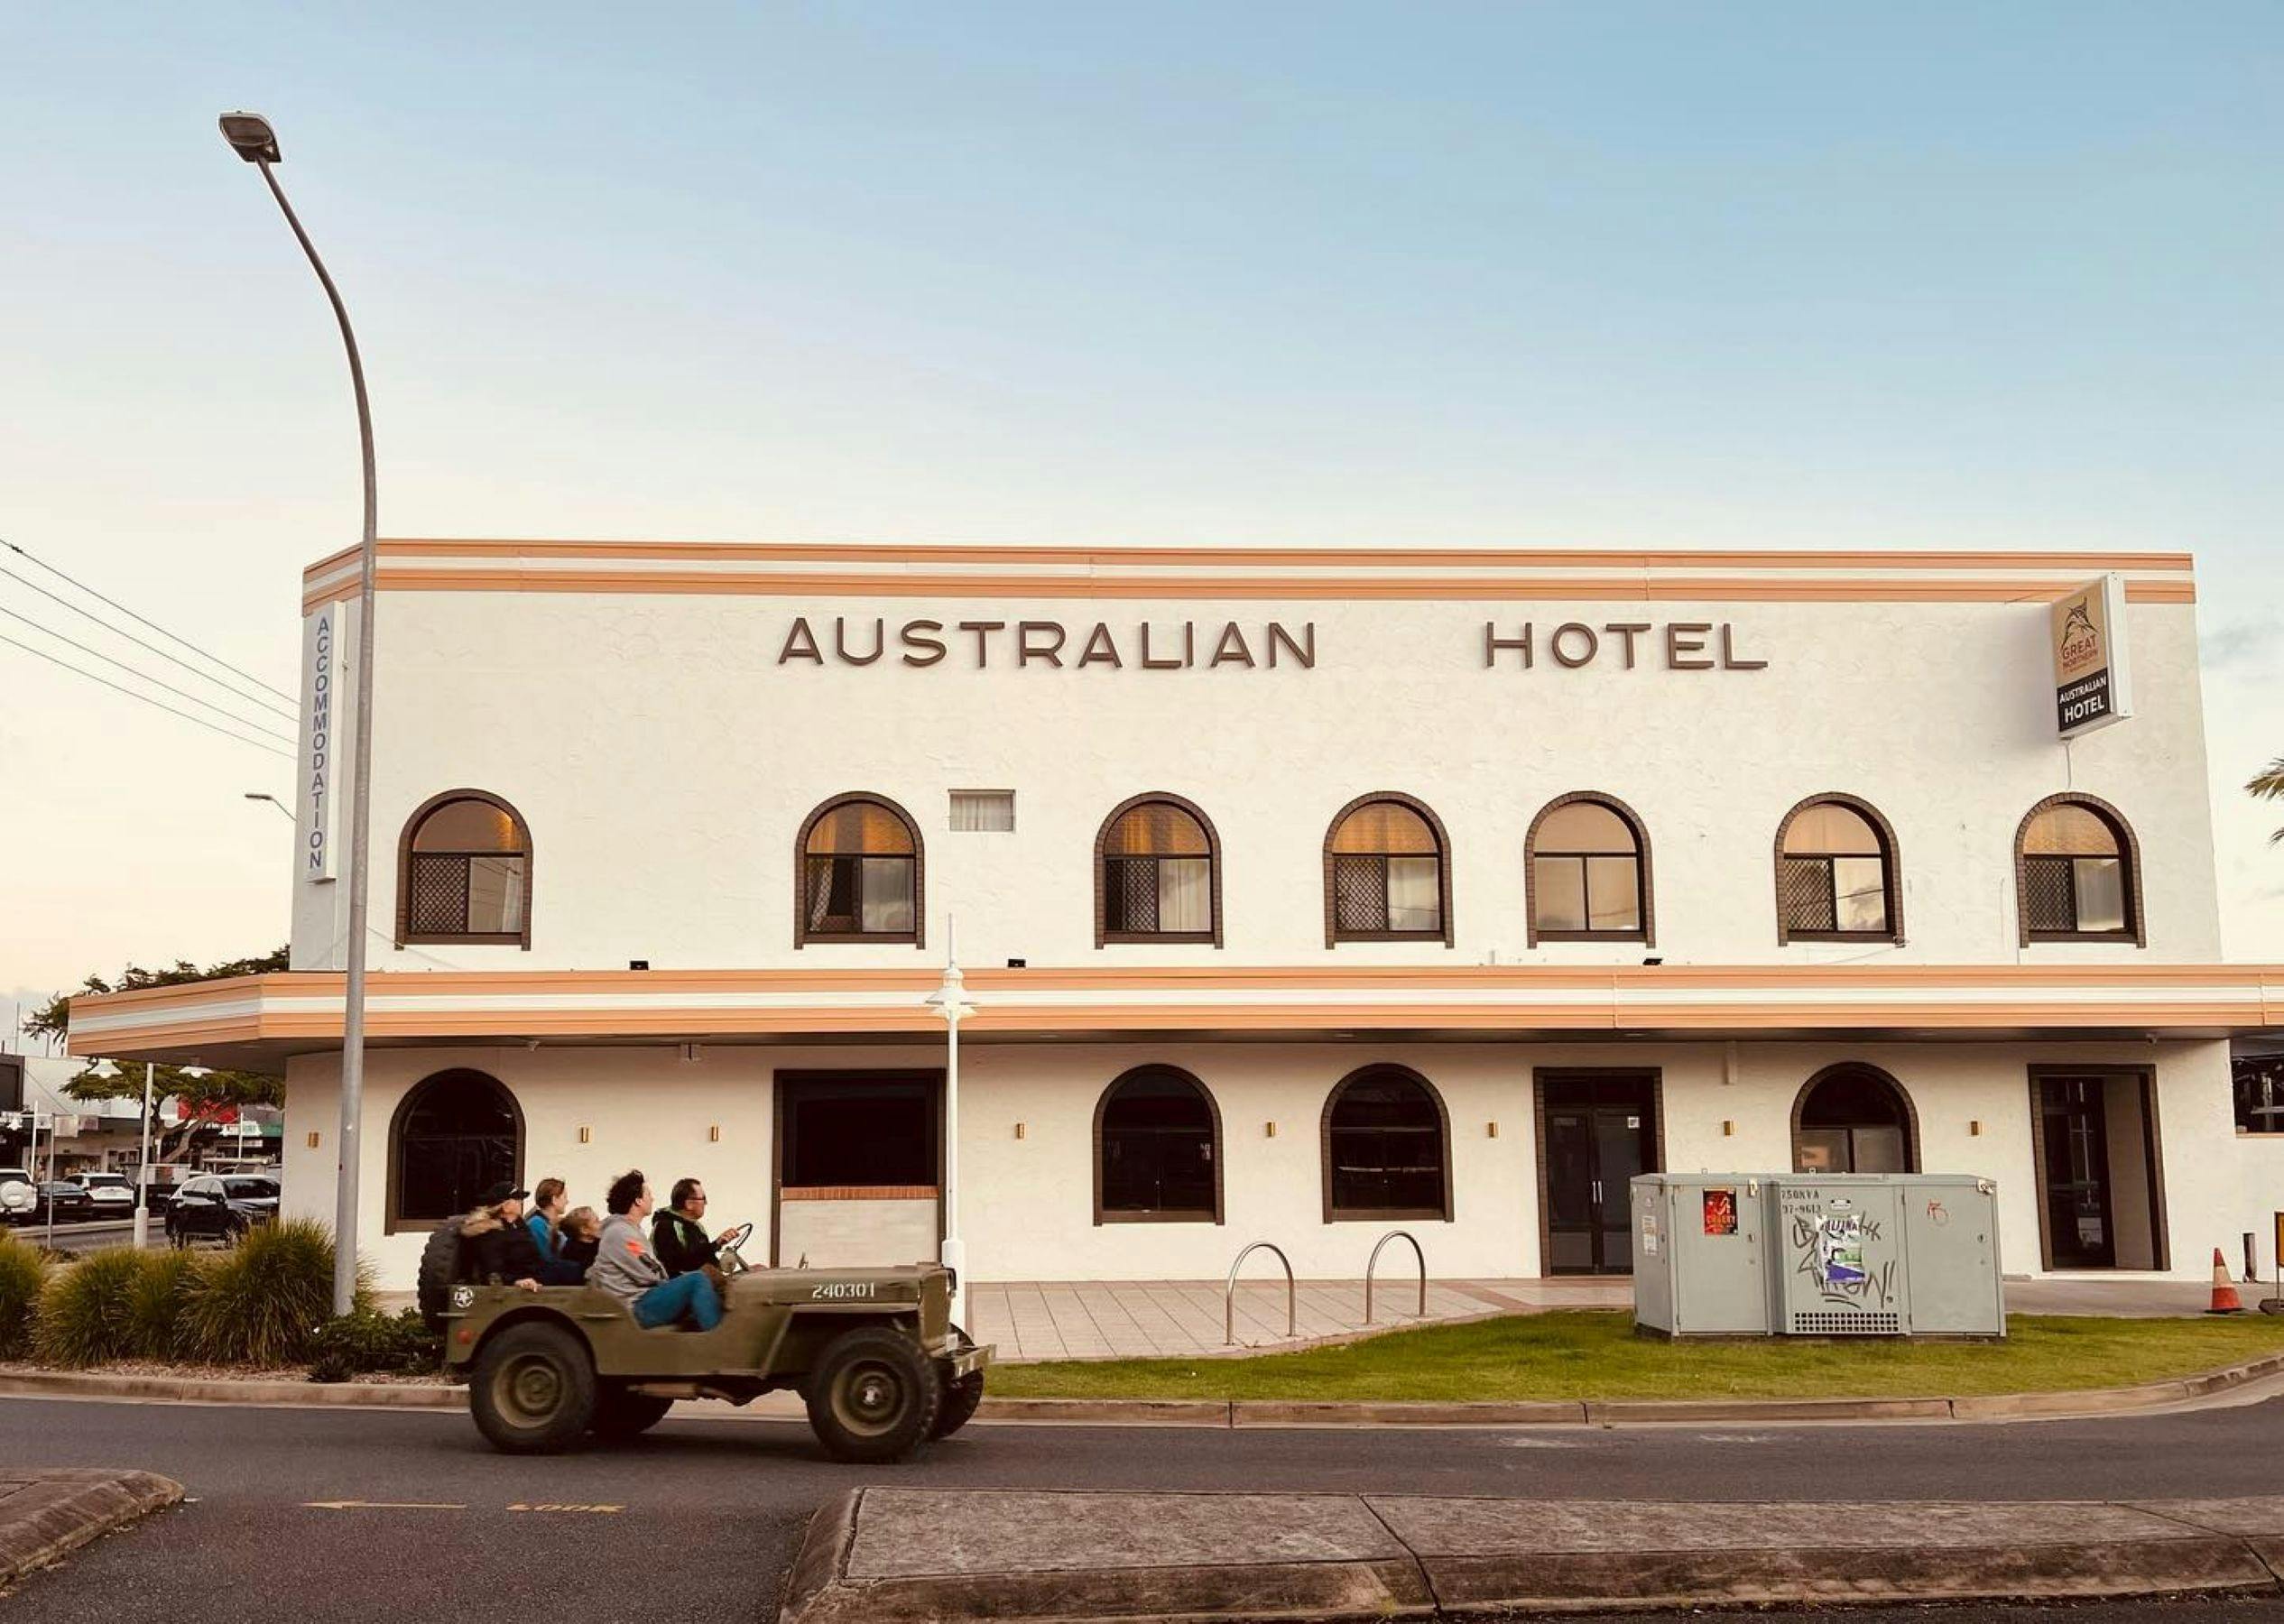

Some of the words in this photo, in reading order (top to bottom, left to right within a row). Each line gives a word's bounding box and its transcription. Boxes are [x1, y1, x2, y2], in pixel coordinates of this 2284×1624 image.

[778, 616, 1316, 669] AUSTRALIAN
[1486, 621, 1769, 670] HOTEL
[2062, 634, 2096, 660] GREAT
[2059, 676, 2107, 704] AUSTRALIAN
[2064, 695, 2105, 723] HOTEL
[310, 616, 328, 869] ACCOMMODATION
[812, 1282, 874, 1299] 240301
